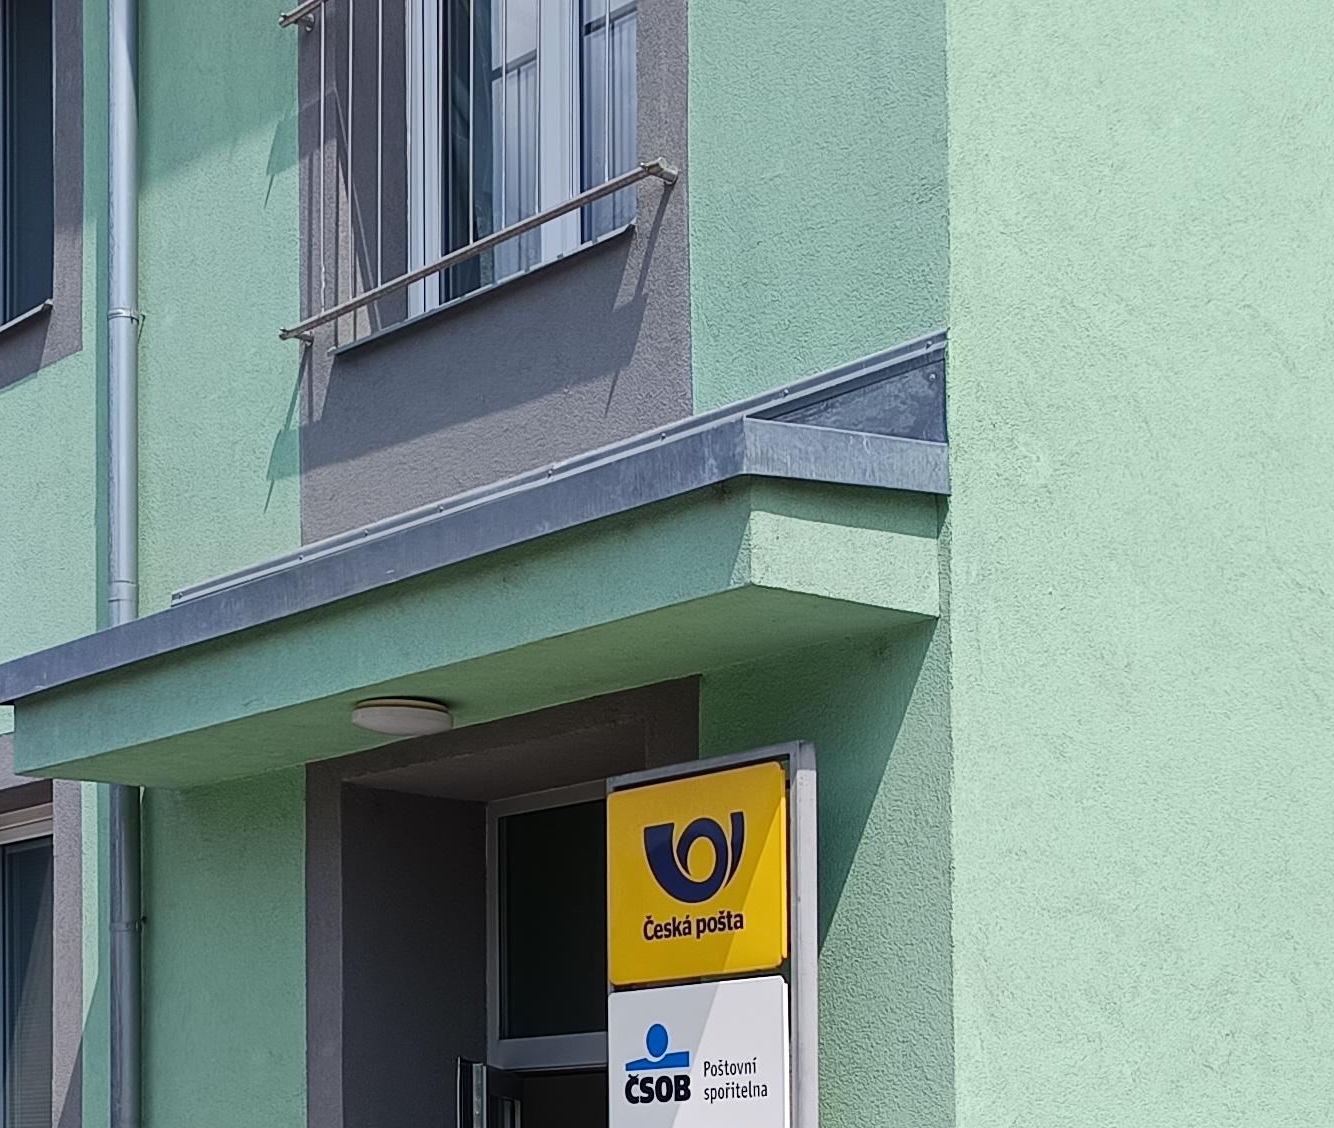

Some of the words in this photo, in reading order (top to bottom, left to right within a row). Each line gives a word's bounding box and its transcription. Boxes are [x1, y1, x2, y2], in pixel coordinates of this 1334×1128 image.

[643, 915, 692, 940] Česká
[696, 910, 744, 939] pošta
[703, 1057, 757, 1077] Poštovní
[625, 1073, 692, 1104] ČSOB
[703, 1080, 768, 1104] spořitelna
